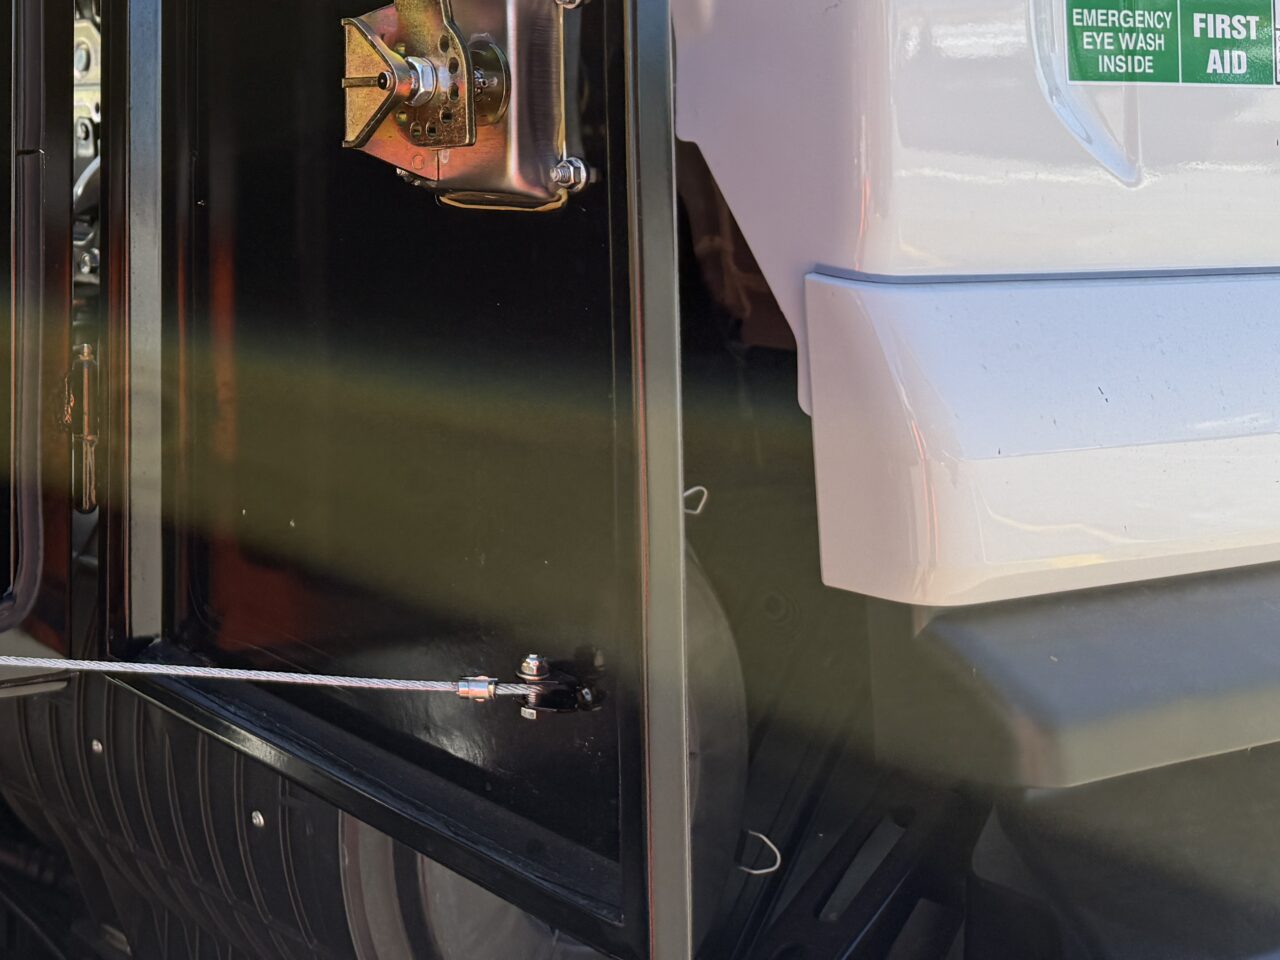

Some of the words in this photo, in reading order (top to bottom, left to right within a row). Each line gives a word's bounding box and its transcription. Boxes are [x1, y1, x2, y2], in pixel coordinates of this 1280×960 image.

[1072, 9, 1172, 28] EMERGENCY
[1193, 13, 1260, 39] FIRST
[1082, 32, 1114, 50] EYE
[1119, 33, 1165, 51] WASH
[1098, 56, 1154, 73] INSIDE
[1207, 49, 1247, 74] AID
